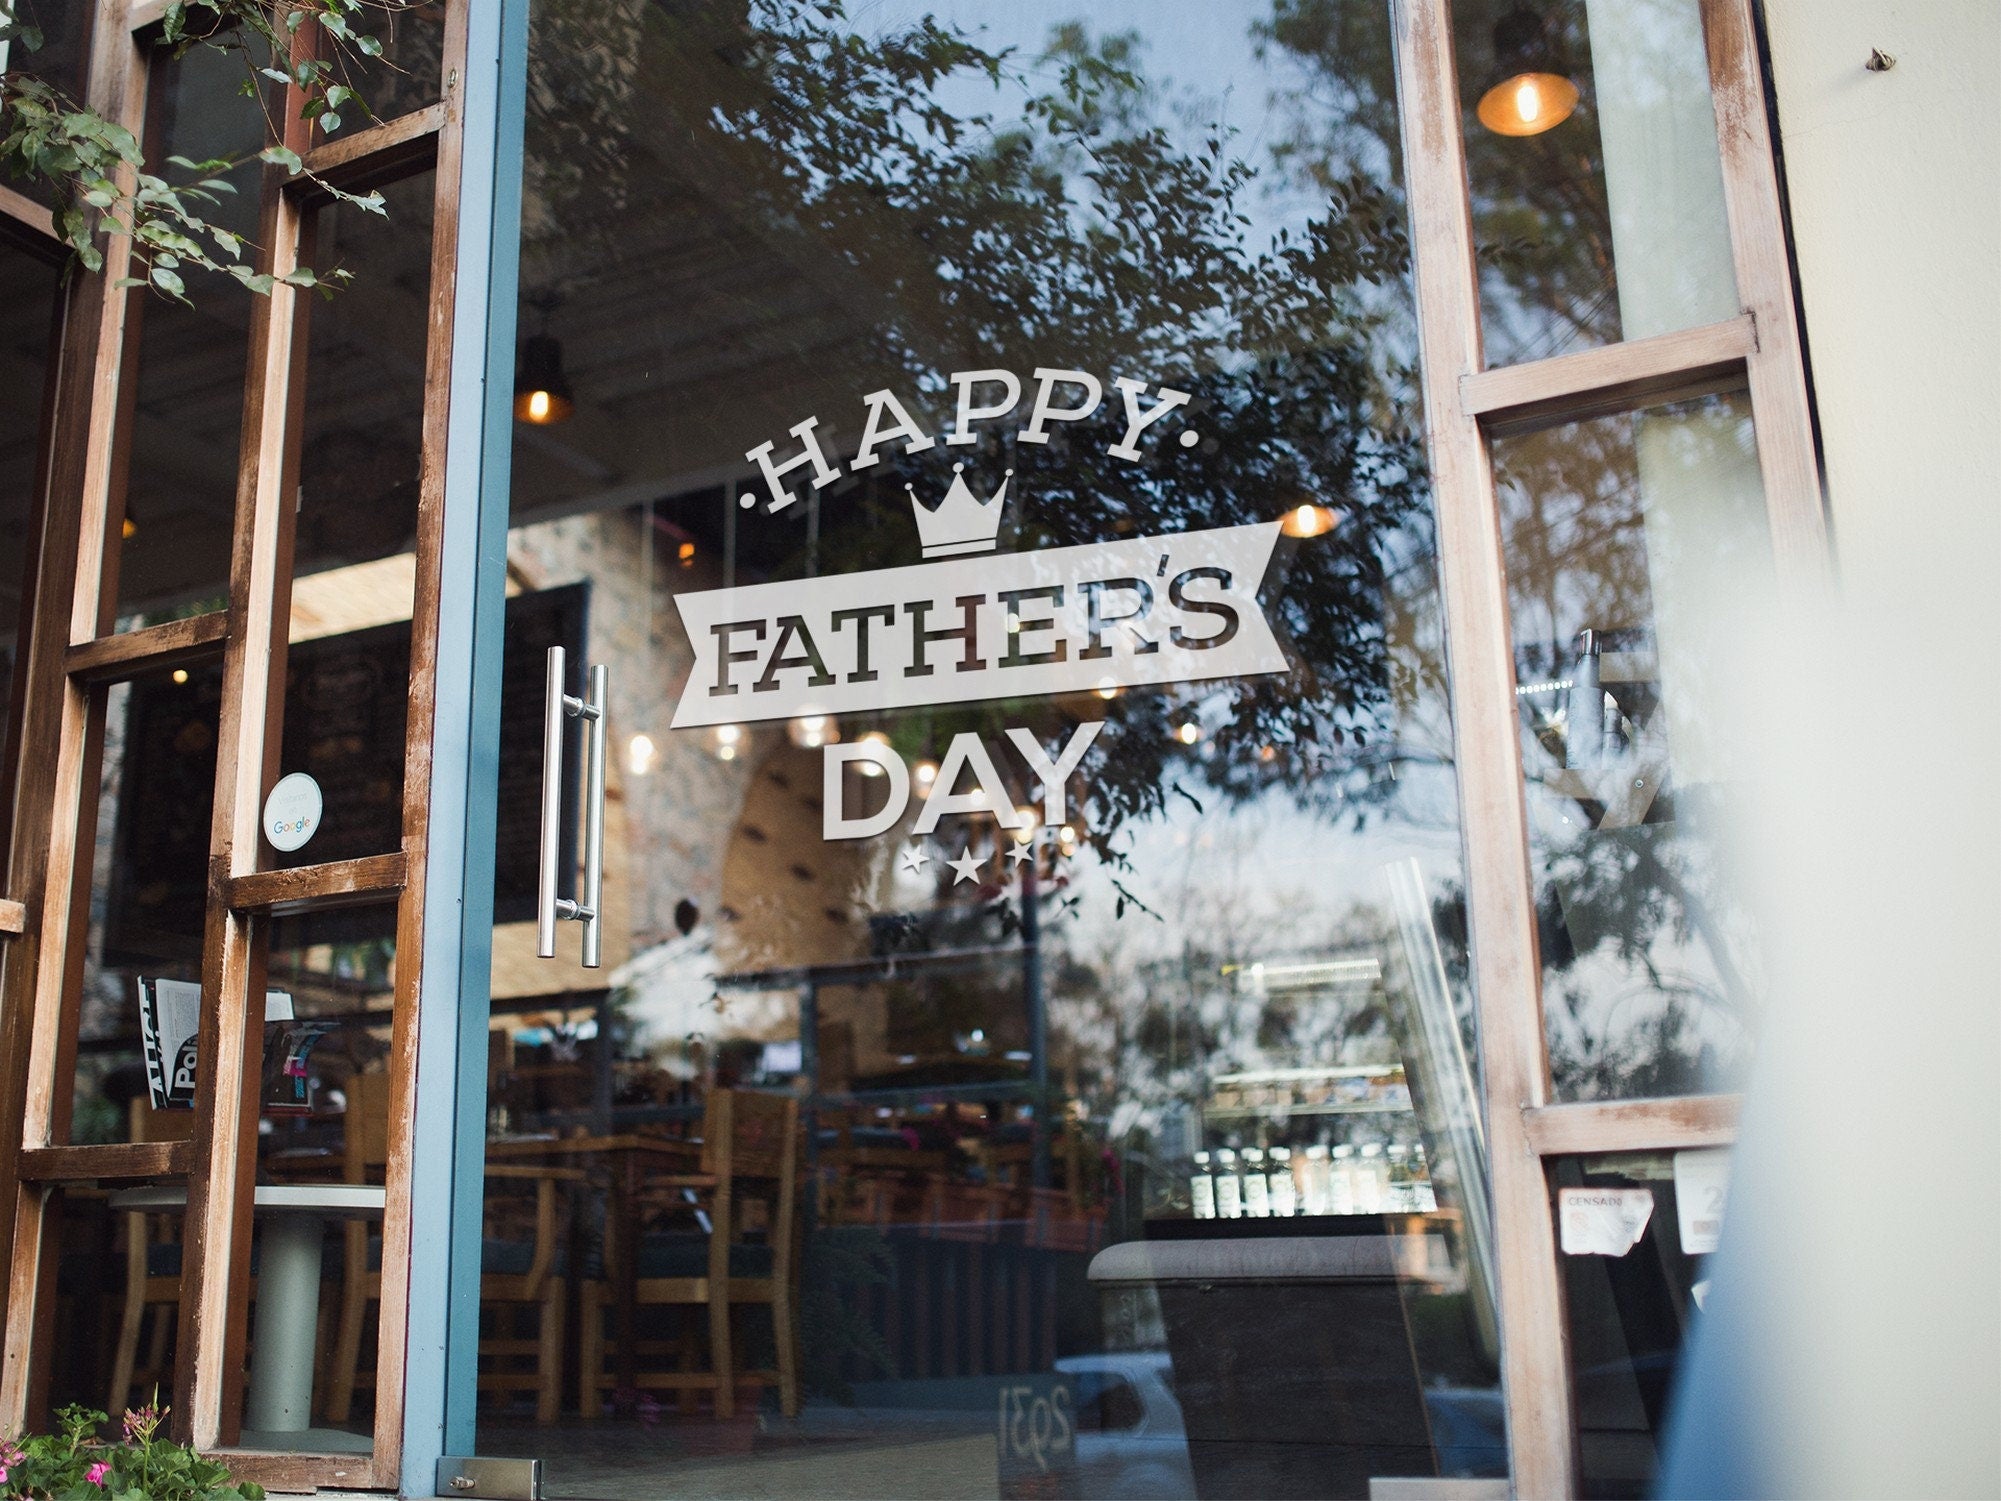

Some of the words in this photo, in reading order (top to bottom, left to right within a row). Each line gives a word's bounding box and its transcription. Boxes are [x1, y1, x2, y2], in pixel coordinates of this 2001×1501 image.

[745, 367, 1192, 514] HAPPY
[708, 554, 1240, 697] FATHER'S
[273, 816, 311, 834] Google
[823, 721, 1105, 841] DAY
